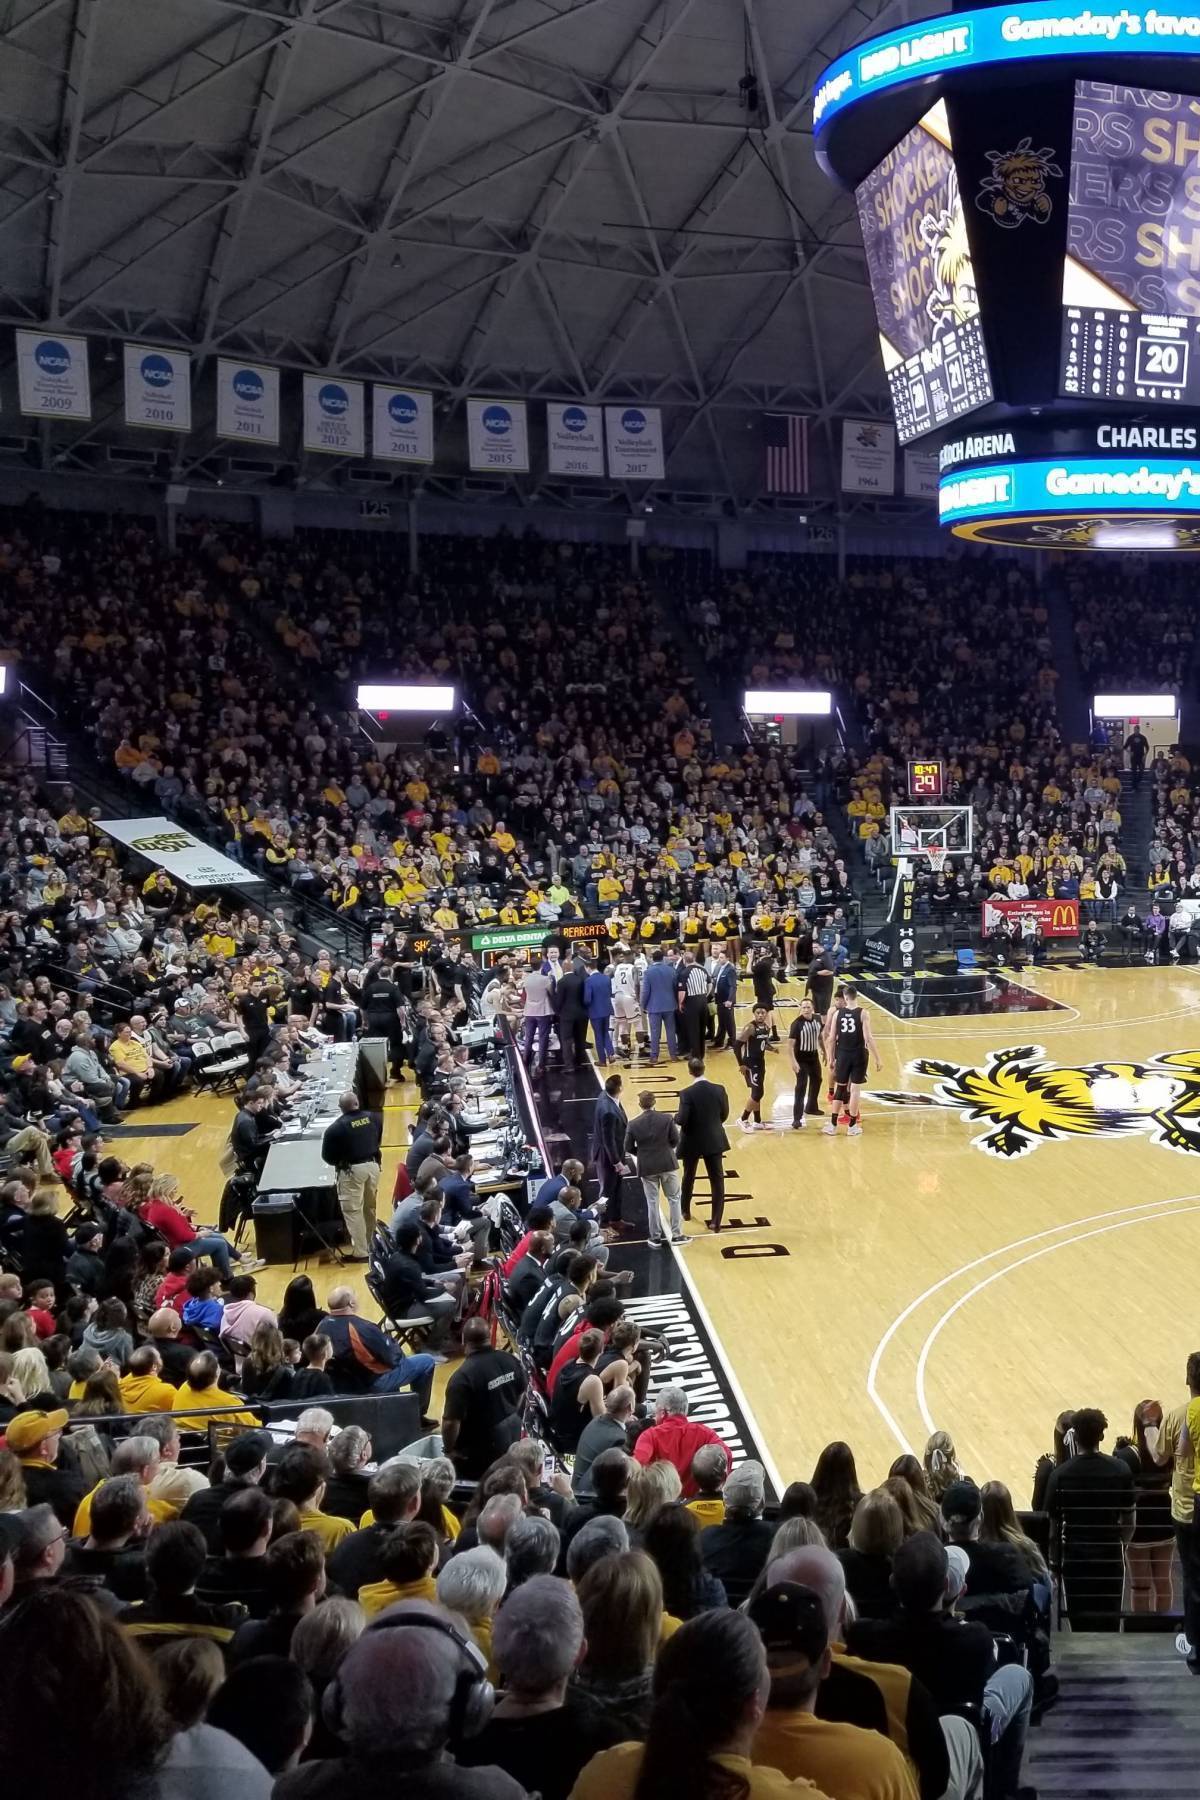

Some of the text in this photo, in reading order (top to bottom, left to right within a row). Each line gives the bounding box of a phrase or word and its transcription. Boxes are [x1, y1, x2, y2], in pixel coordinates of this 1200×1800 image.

[1001, 10, 1141, 41] Gameday's
[900, 27, 968, 63] LIGHT
[1145, 345, 1179, 374] 20
[1065, 365, 1079, 377] 21
[964, 433, 1016, 459] ARENA
[1097, 425, 1197, 450] CHARLES
[915, 775, 935, 792] 29
[903, 880, 915, 920] WSU
[492, 935, 515, 944] DELTA
[564, 925, 606, 937] BEARCATS
[620, 970, 628, 984] 2
[840, 1017, 856, 1033] 33
[350, 1116, 371, 1129] POLICE
